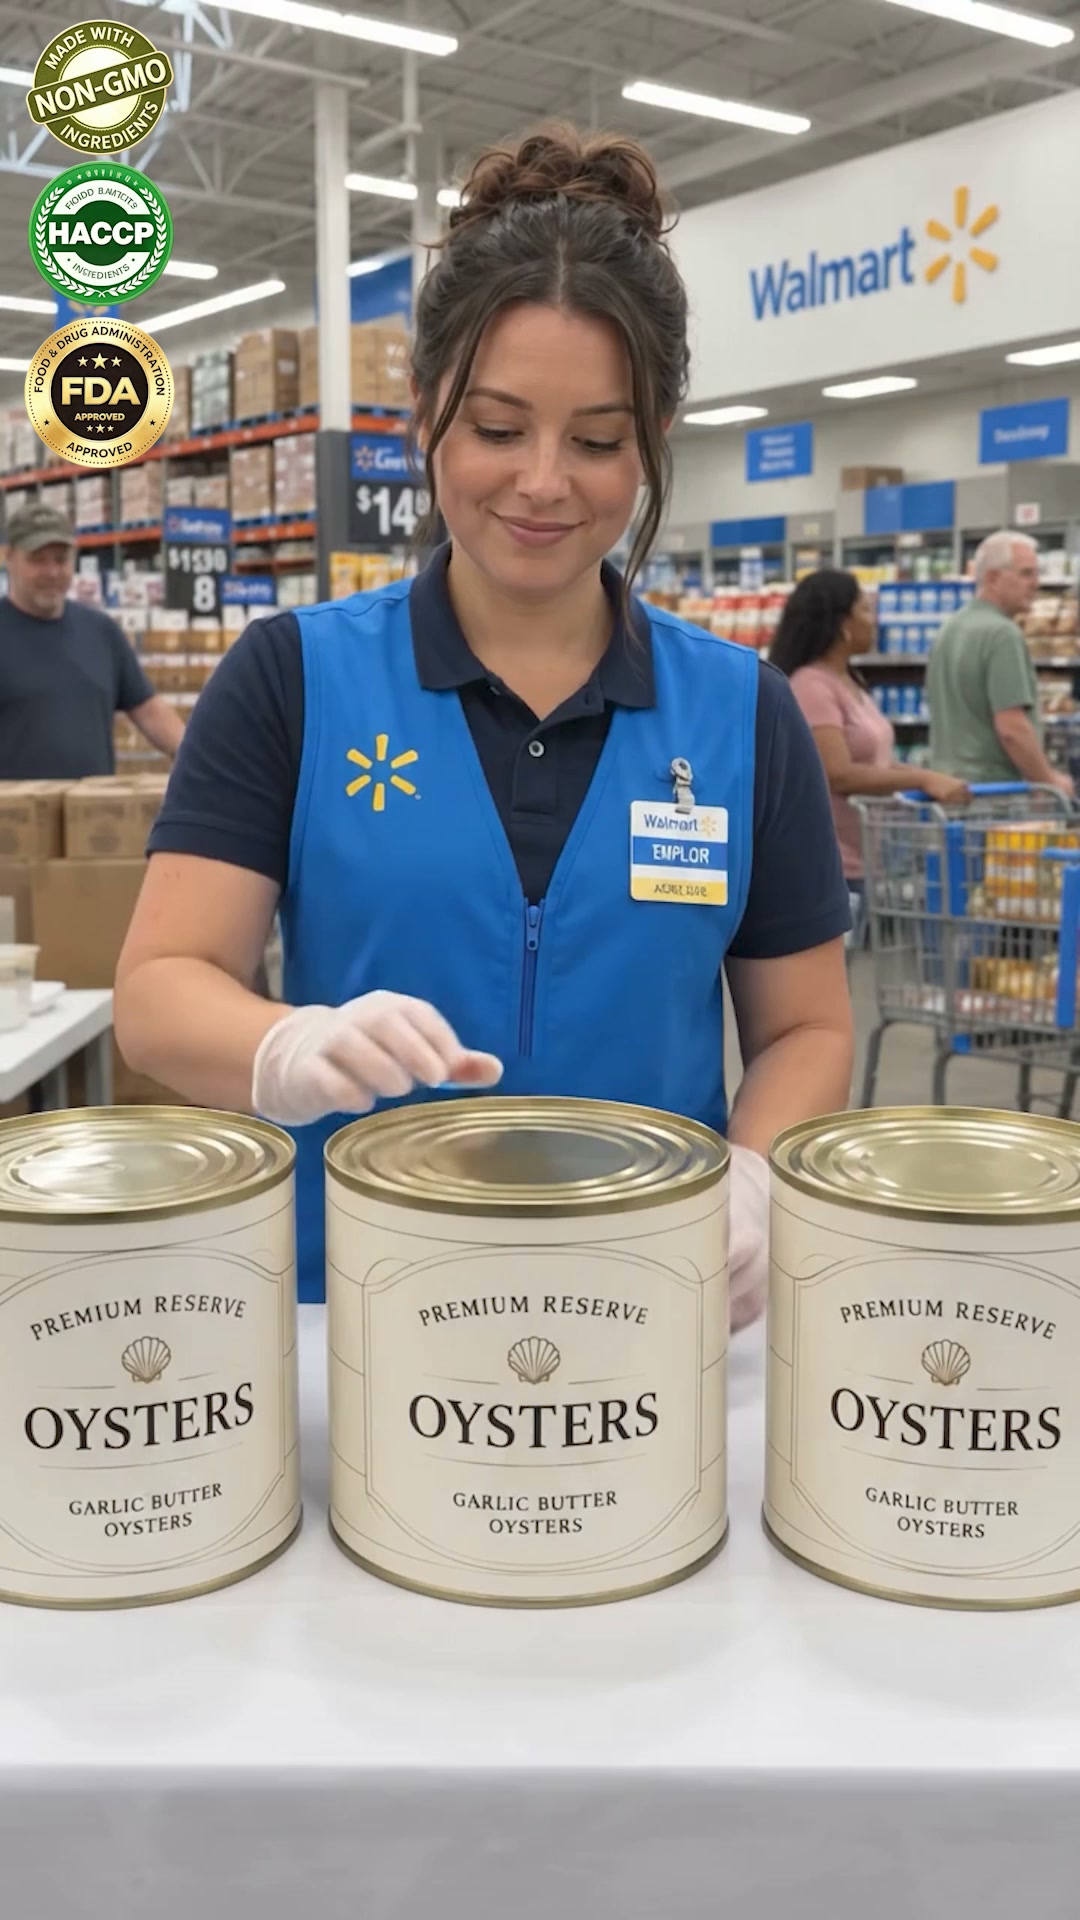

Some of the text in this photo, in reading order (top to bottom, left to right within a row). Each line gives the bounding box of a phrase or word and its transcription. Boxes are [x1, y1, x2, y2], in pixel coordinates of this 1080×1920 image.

[750, 226, 915, 321] Walmart
[193, 575, 216, 612] 8
[644, 814, 699, 832] Walmart
[30, 1294, 247, 1341] PREMIUM RESERVE
[418, 1296, 649, 1326] PREMIUM RESERVE
[840, 1299, 1057, 1340] PREMIUM RESERVE
[24, 1382, 254, 1451] OYSTERS
[409, 1392, 659, 1448] OYSTERS
[831, 1387, 1061, 1451] OYSTERS
[69, 1482, 222, 1516] GARLIC BUTTER
[453, 1490, 617, 1511] GARLIC BUTTER
[865, 1486, 1019, 1516] GARLIC BUTTER
[104, 1512, 193, 1537] OYSTERS
[489, 1518, 583, 1534] OYSTERS
[897, 1516, 985, 1538] OYSTERS
